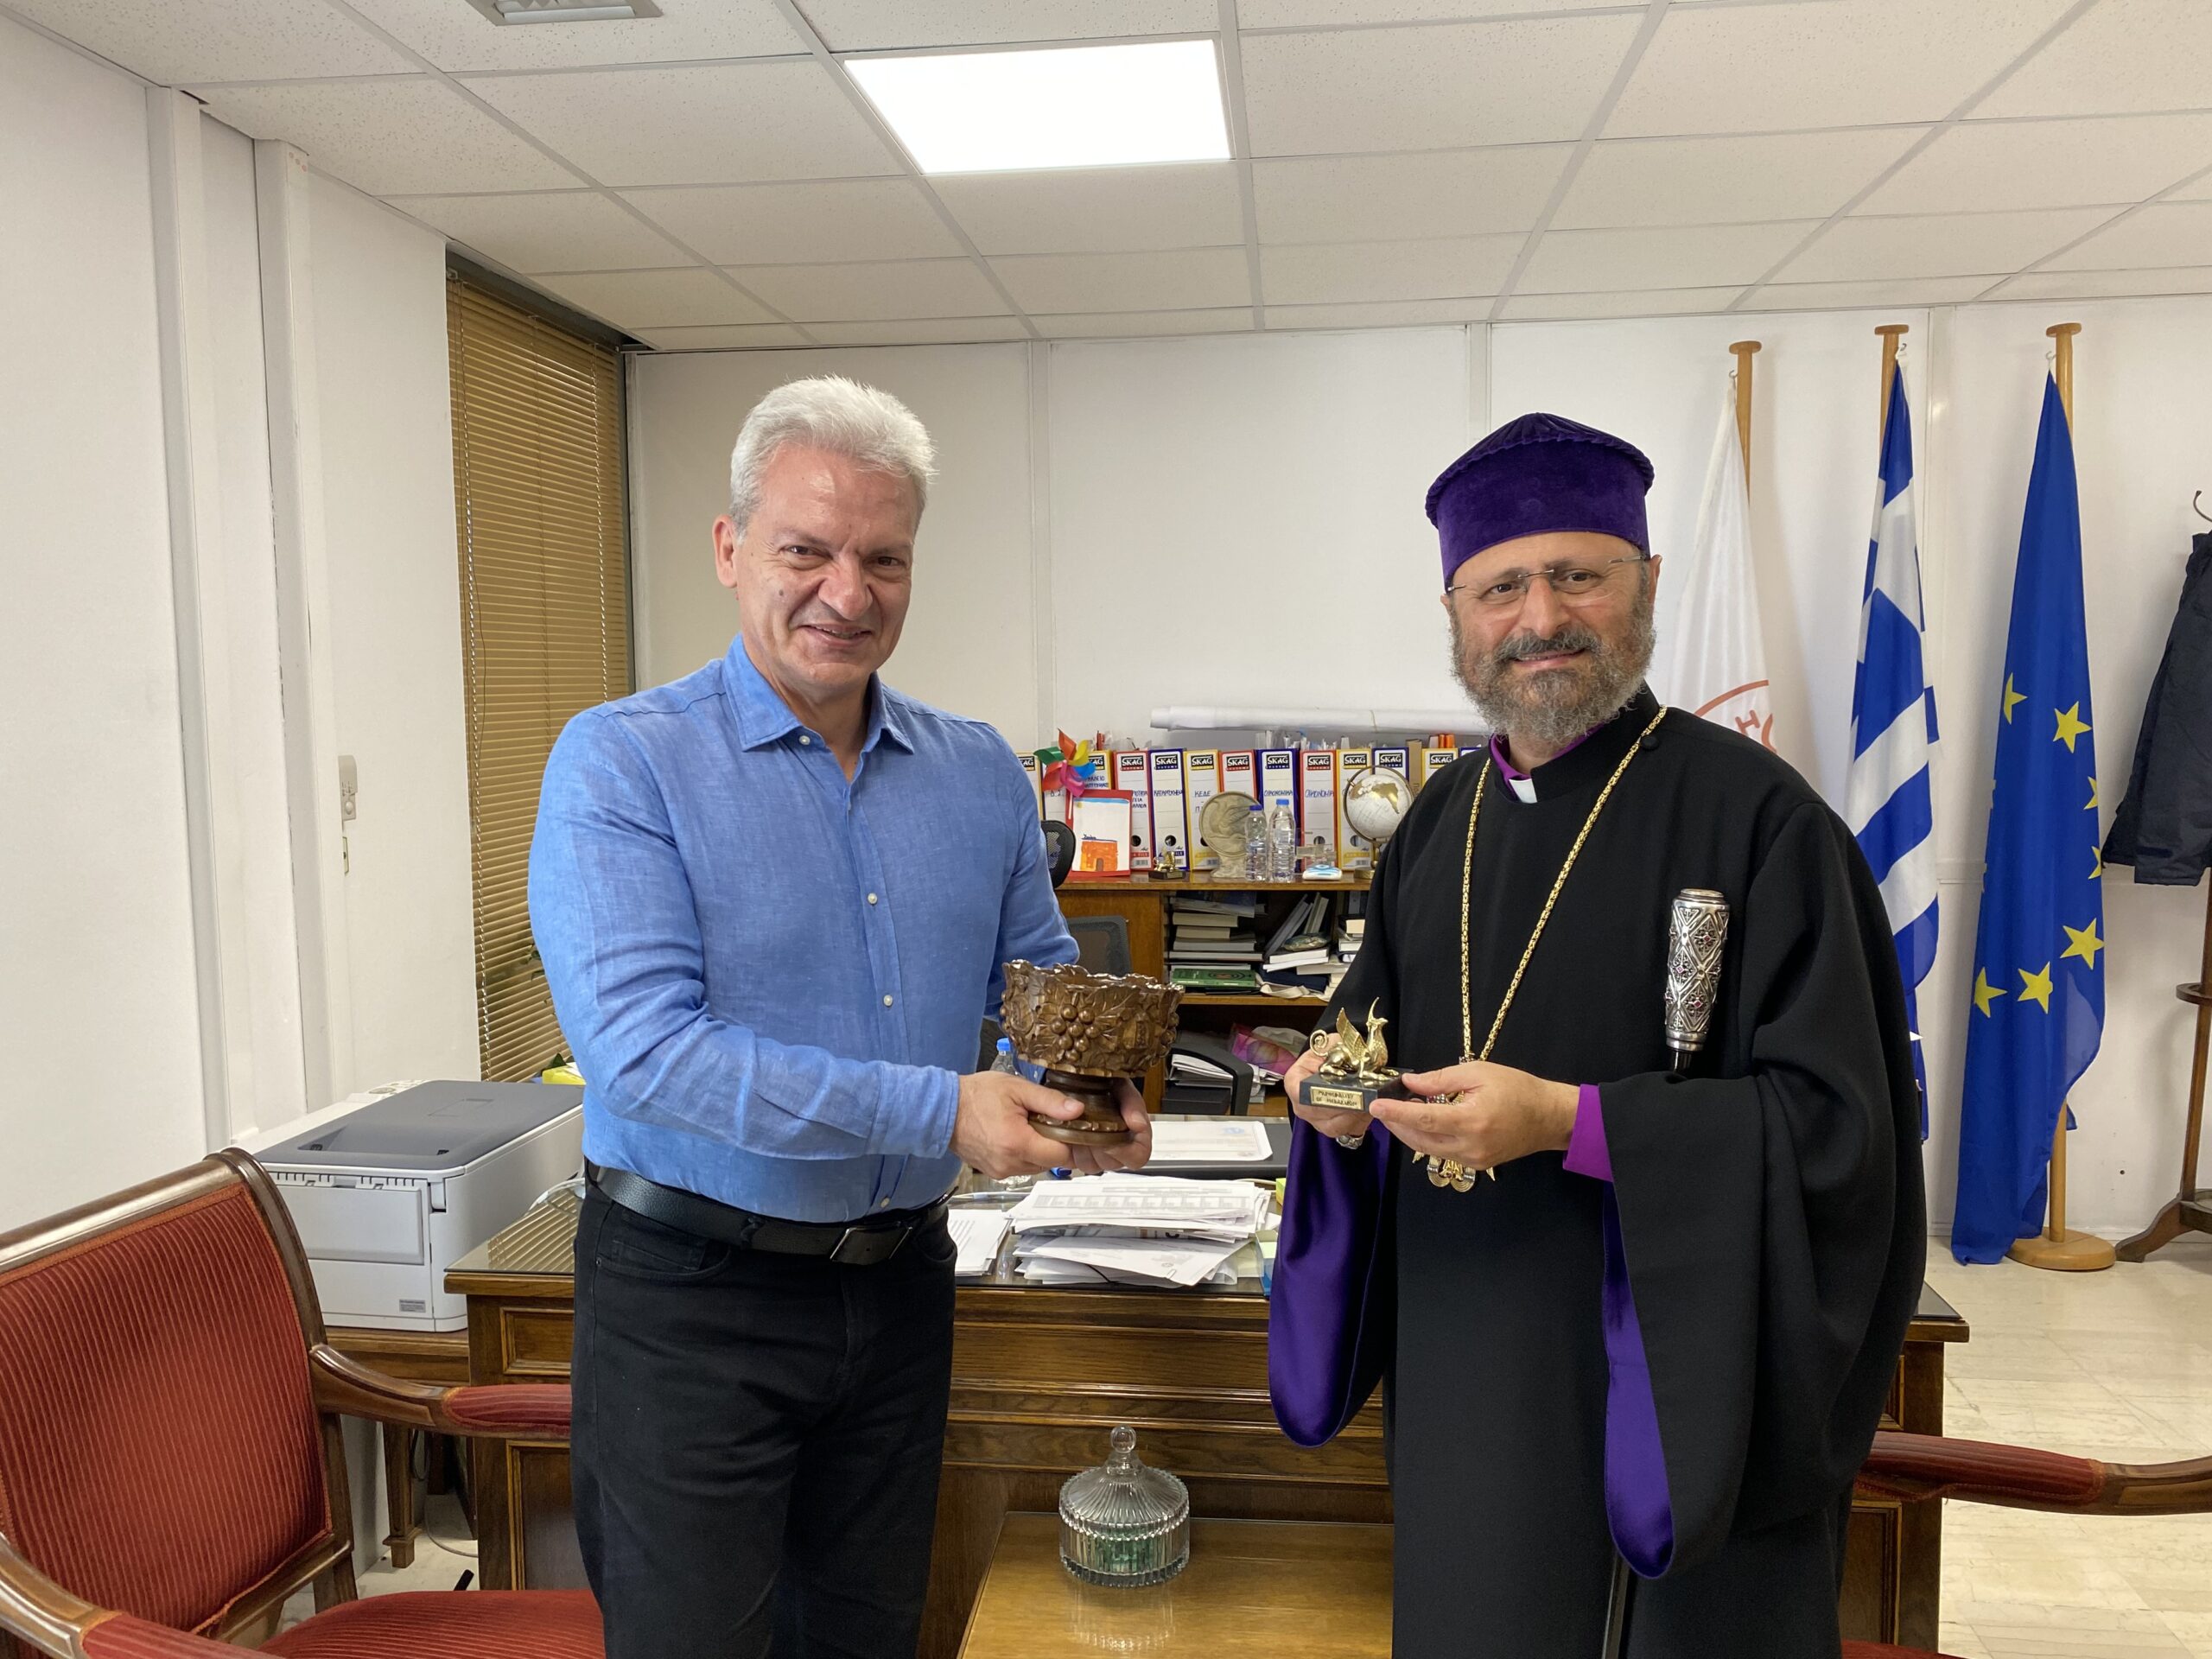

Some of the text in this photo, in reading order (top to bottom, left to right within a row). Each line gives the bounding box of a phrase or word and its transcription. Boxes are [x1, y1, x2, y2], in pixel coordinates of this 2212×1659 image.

[1122, 756, 1143, 766] SKAG
[1156, 754, 1177, 766] SKAG
[1192, 756, 1213, 766] SKAG
[1227, 756, 1249, 766] SKAG
[1267, 754, 1288, 765] SKAG
[1308, 756, 1330, 766] SKAG
[1344, 754, 1366, 764] SKAG
[1380, 753, 1402, 763] SKAG
[1430, 754, 1452, 763] SKAG
